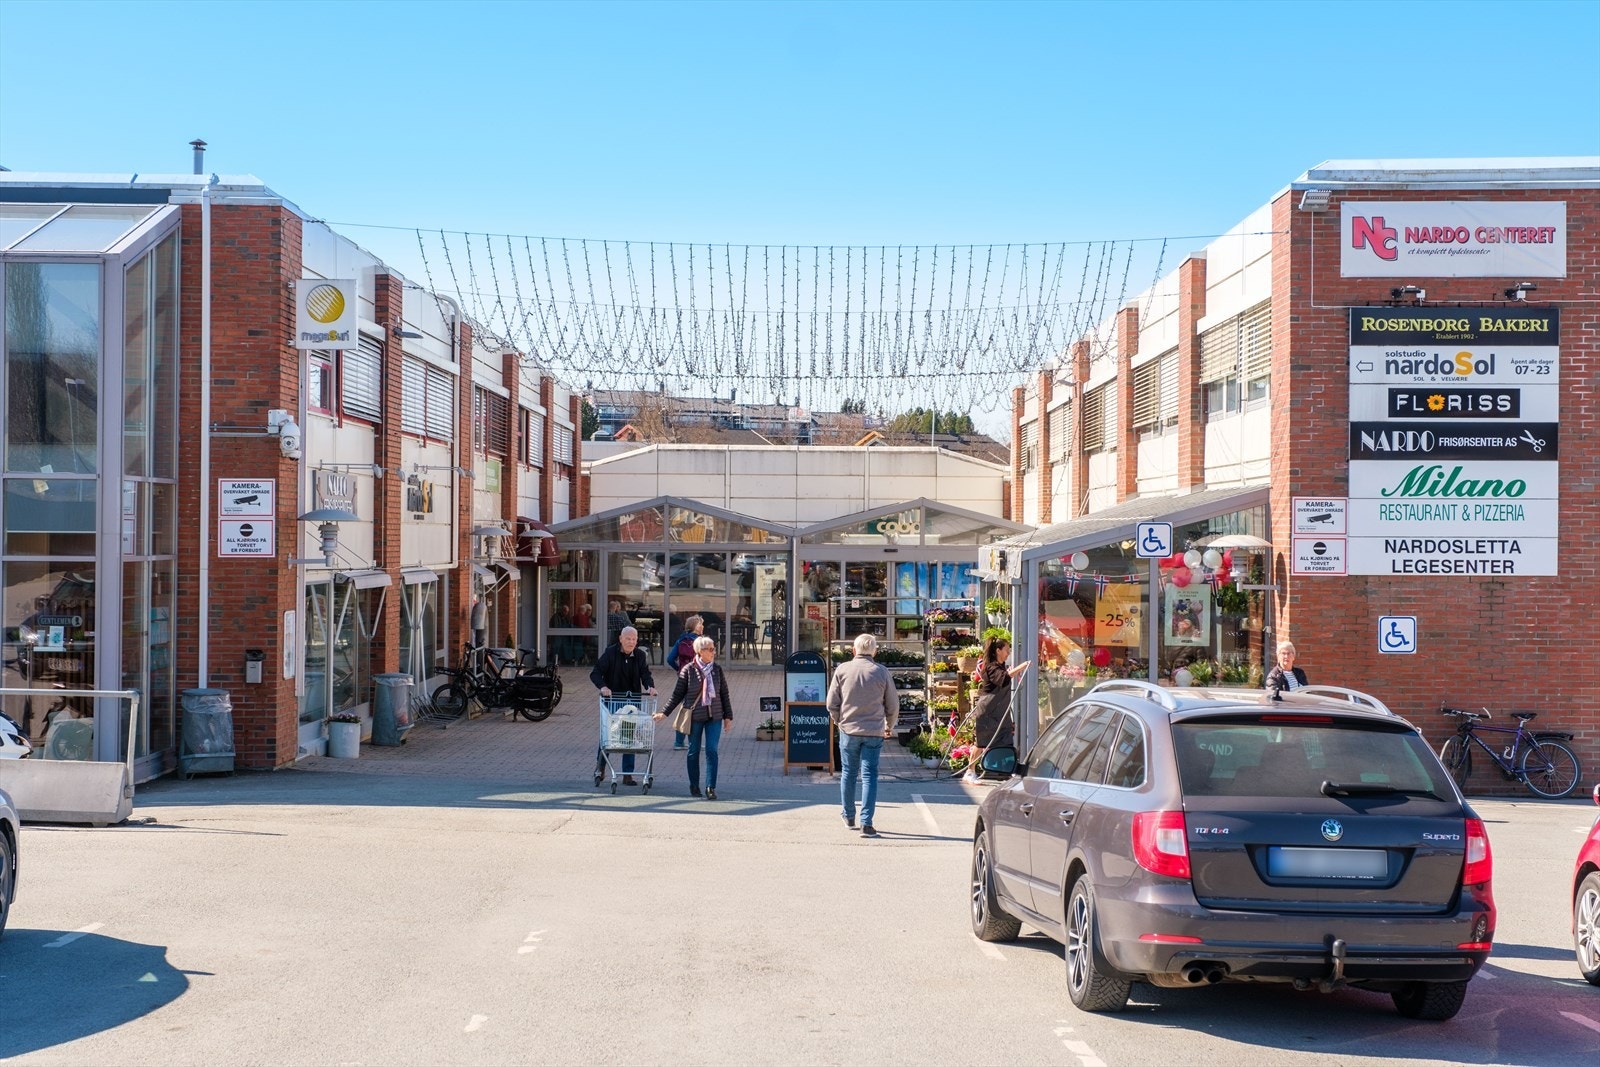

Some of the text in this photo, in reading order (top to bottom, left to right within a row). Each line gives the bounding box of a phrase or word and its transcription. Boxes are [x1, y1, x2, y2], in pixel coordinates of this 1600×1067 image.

[1404, 226, 1556, 244] NARDO CENTERET
[1416, 248, 1447, 256] komplett
[1361, 317, 1549, 332] ROSENBORG BAKERI
[1385, 351, 1495, 375] nardoSol
[1510, 357, 1527, 365] Åpent
[1539, 358, 1554, 366] dager
[1396, 394, 1511, 412] FLORISS
[1360, 430, 1517, 453] NARDO FRISØRSENTER AS
[1380, 464, 1527, 498] Milano
[1379, 503, 1525, 522] RESTAURANT & PIZZERIA
[1384, 539, 1522, 554] NARDOSLETTA
[1391, 559, 1515, 574] LEGESENTER
[40, 617, 72, 625] GENTLEMEN
[790, 714, 830, 726] KONFIRMASJON
[1422, 832, 1460, 841] Superb
